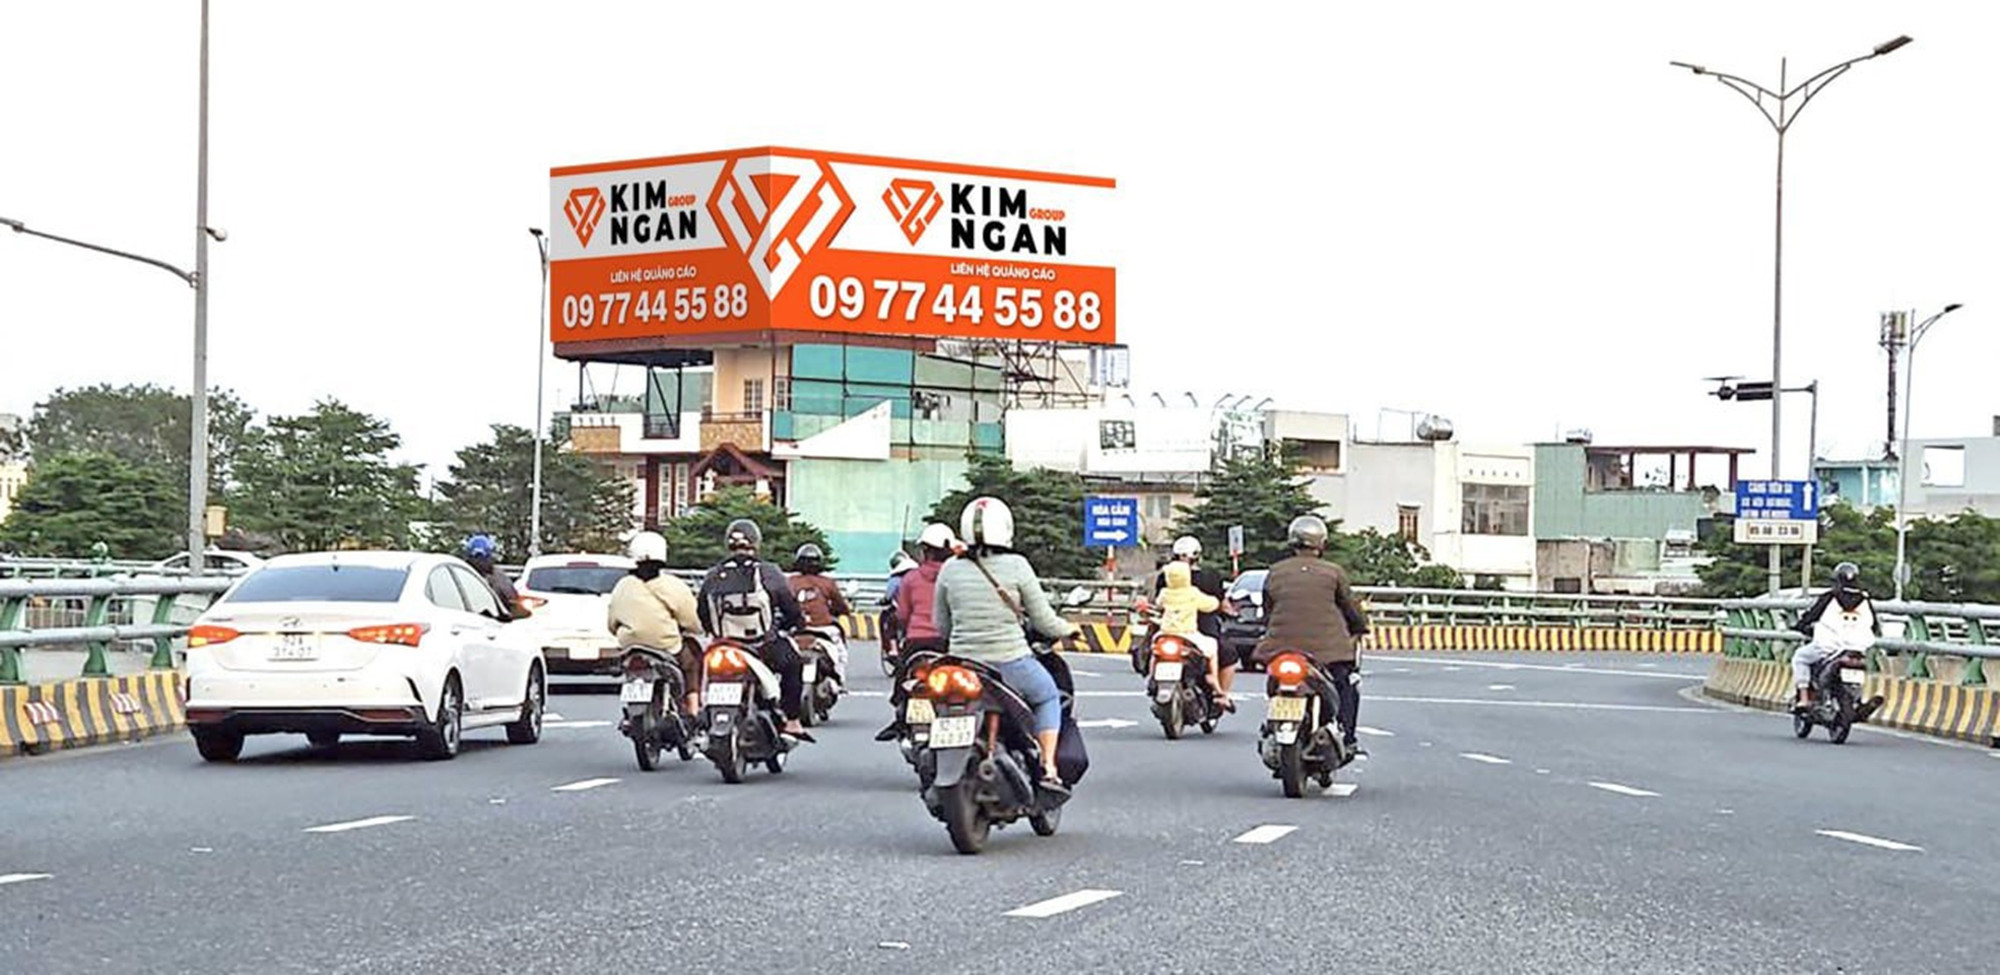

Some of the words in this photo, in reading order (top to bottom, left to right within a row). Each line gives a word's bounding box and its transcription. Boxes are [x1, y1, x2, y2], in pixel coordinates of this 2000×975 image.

[611, 180, 666, 213] KIM
[668, 195, 697, 207] GROUP
[951, 183, 1027, 219] KIM
[1029, 208, 1065, 221] GROUP
[611, 210, 697, 245] NGAN
[951, 218, 1066, 256] NGAN
[611, 269, 630, 283] LIÊN
[631, 268, 643, 283] HỆ
[644, 265, 675, 281] QUẢNG
[676, 266, 697, 278] CÁO
[951, 262, 974, 276] LIÊN
[976, 264, 990, 278] HỆ
[992, 264, 1030, 279] QUẢNG
[1032, 266, 1055, 280] CÁO
[562, 294, 595, 329] 09
[599, 292, 631, 326] 77
[635, 290, 667, 323] 44
[674, 286, 707, 321] 55
[713, 283, 748, 319] 88
[810, 275, 865, 319] 09
[873, 280, 926, 321] 77
[931, 283, 983, 324] 44
[993, 286, 1043, 328] 55
[1053, 289, 1101, 331] 88
